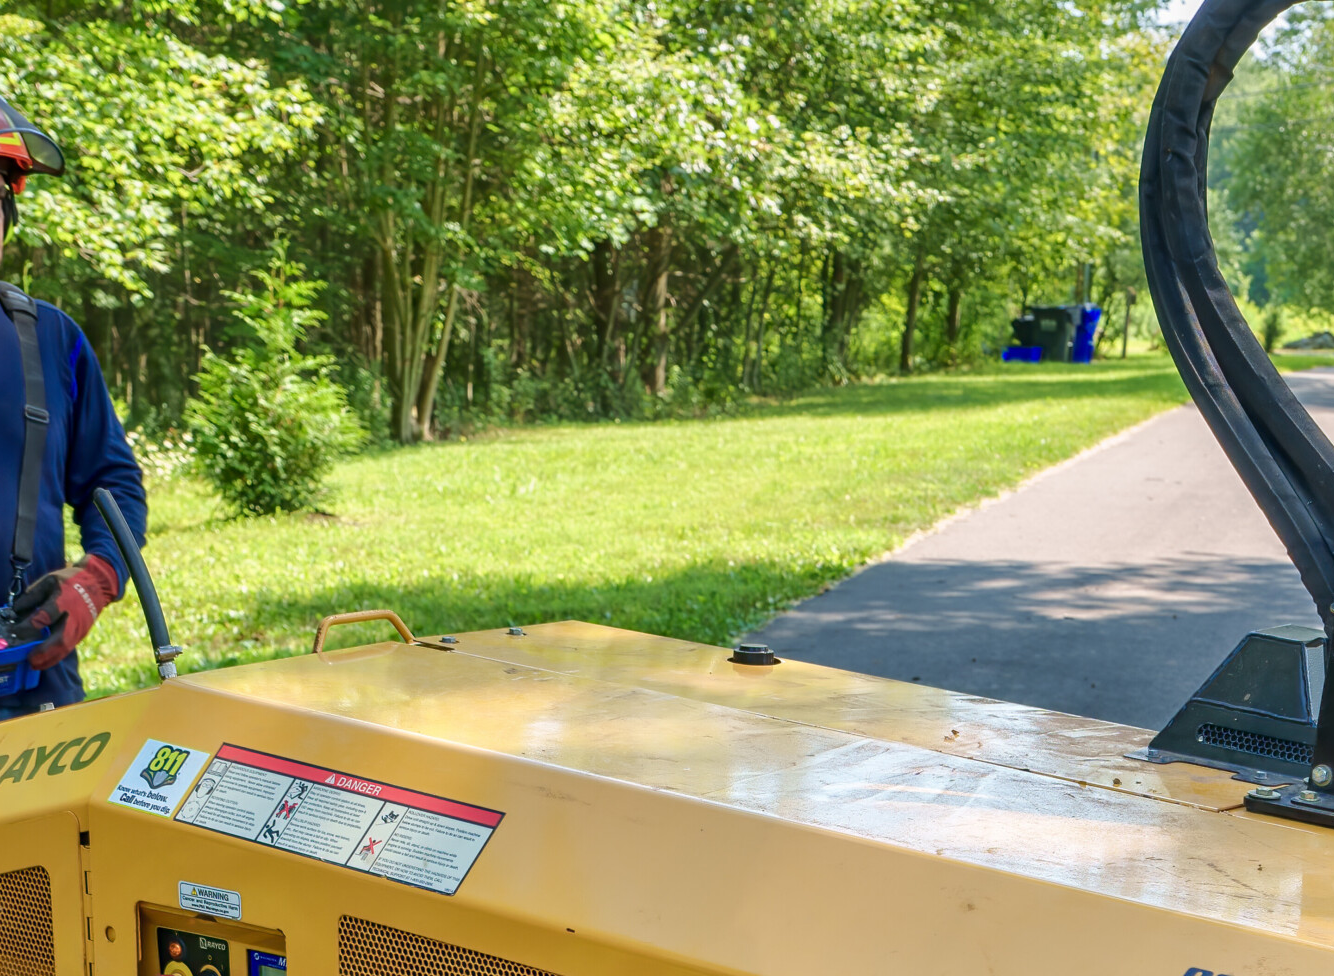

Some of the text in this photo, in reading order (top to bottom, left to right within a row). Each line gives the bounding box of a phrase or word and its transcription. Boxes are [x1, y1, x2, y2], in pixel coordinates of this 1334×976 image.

[148, 745, 190, 776] 811
[117, 784, 131, 793] Know
[336, 776, 382, 796] DANGER
[119, 792, 136, 804] Call
[133, 797, 151, 809] before
[150, 802, 162, 812] you
[197, 888, 229, 902] WARNING
[206, 940, 226, 951] RAYCO
